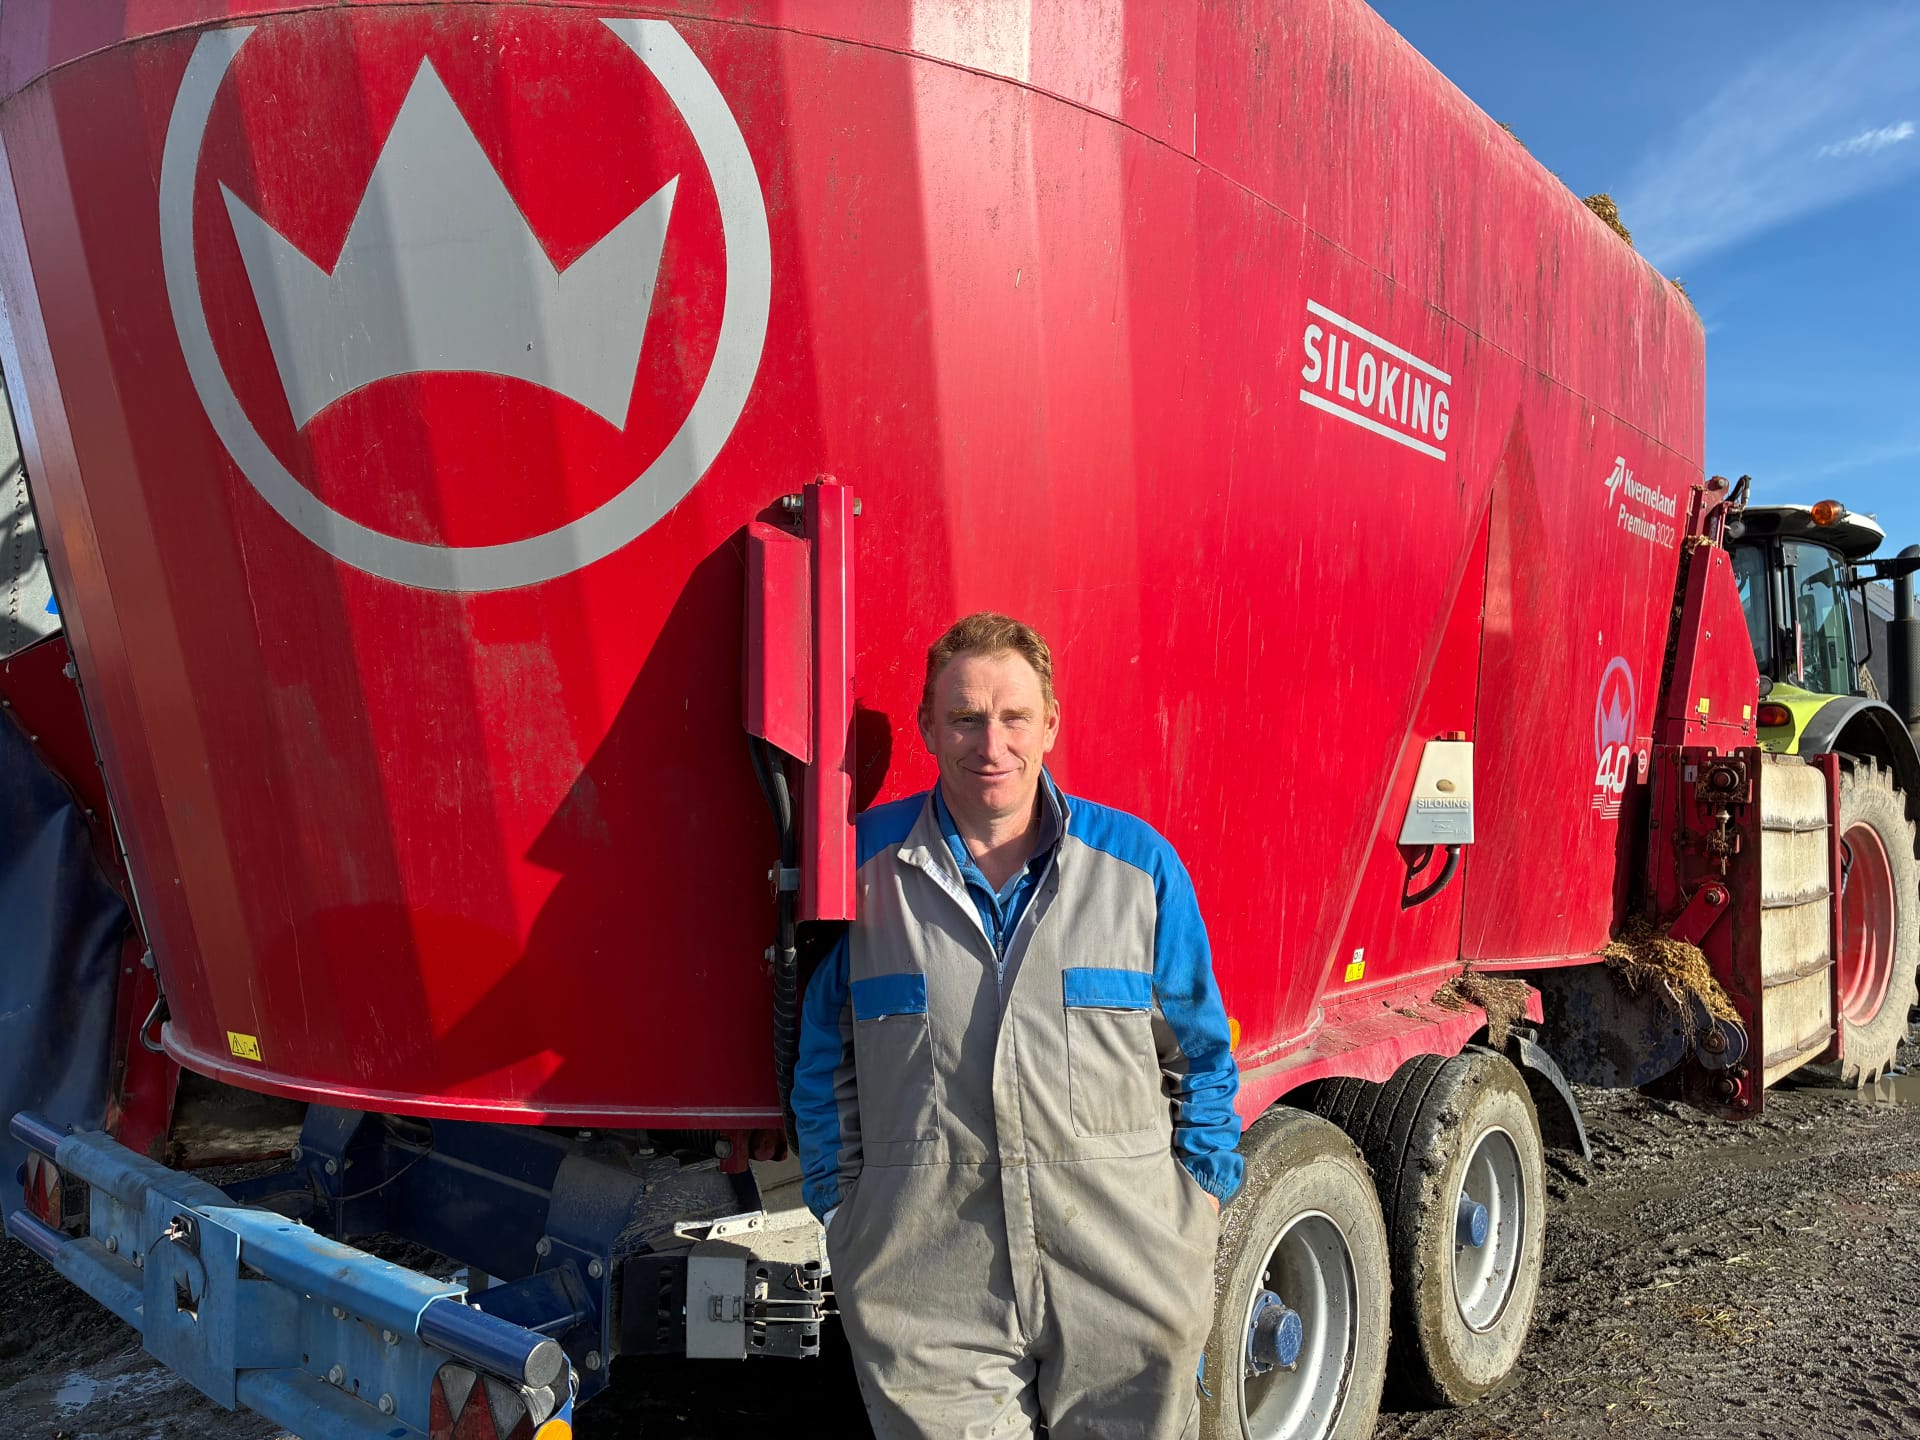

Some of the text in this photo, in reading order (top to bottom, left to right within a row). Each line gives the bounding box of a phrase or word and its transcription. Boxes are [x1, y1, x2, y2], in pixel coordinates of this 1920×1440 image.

[1301, 324, 1450, 441] SILOKING
[1624, 469, 1677, 518] Kverneland
[1417, 799, 1469, 809] SILOKING
